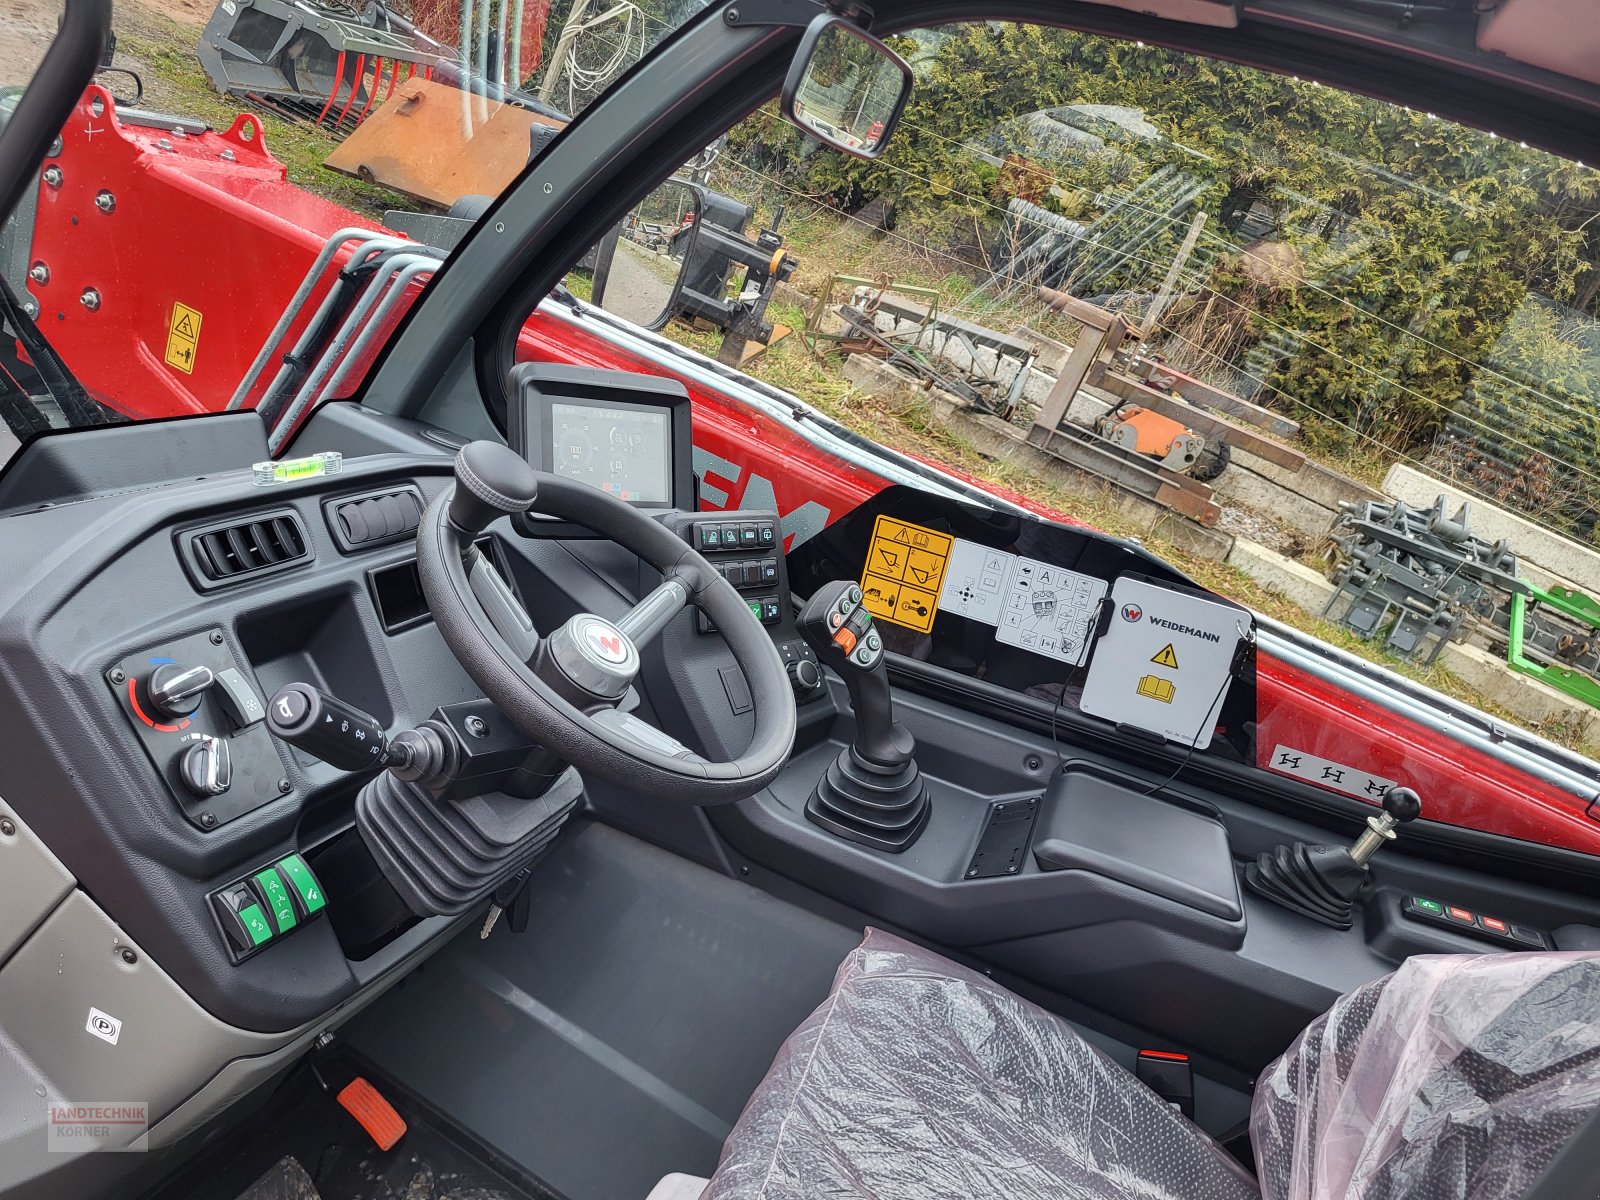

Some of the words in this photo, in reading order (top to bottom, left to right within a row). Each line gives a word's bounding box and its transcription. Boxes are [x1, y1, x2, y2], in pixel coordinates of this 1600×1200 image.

[1040, 571, 1051, 583] A
[1149, 615, 1220, 643] WEIDEMANN
[181, 734, 191, 743] OFF
